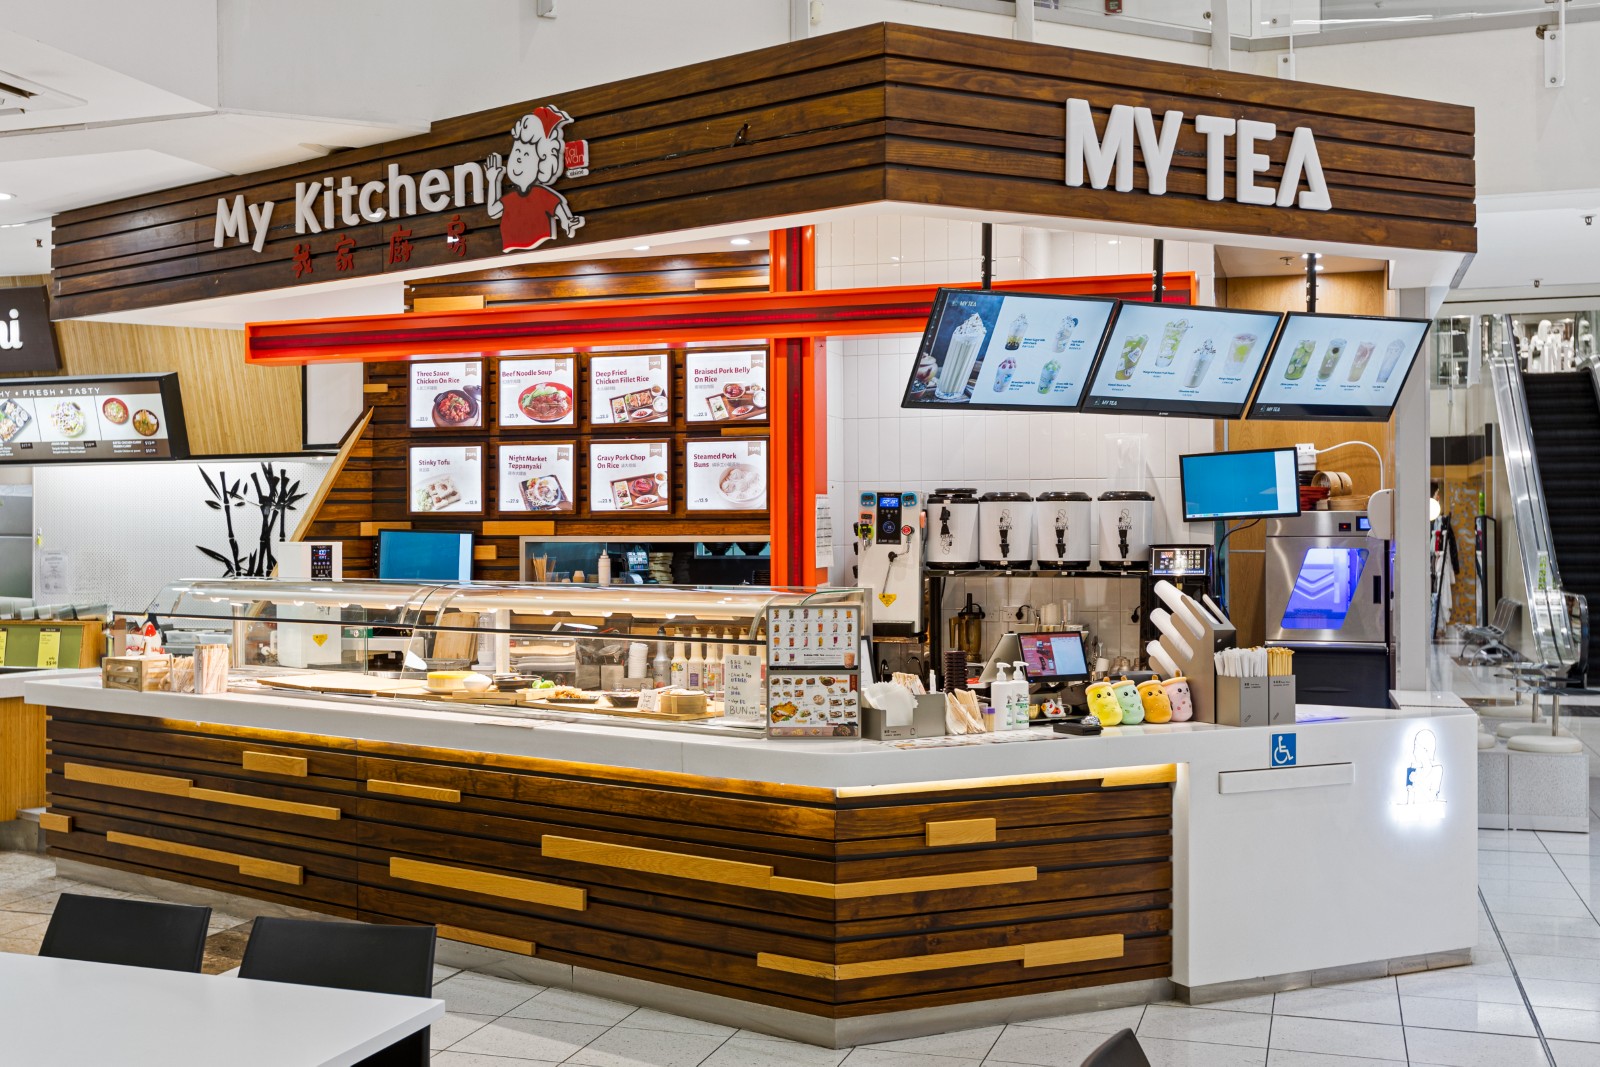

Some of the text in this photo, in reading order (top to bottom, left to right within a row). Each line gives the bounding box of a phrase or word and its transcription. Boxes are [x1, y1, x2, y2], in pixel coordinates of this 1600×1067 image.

[1066, 98, 1332, 210] MY TEA
[214, 162, 484, 253] My Kitchen
[729, 706, 748, 714] BUN
